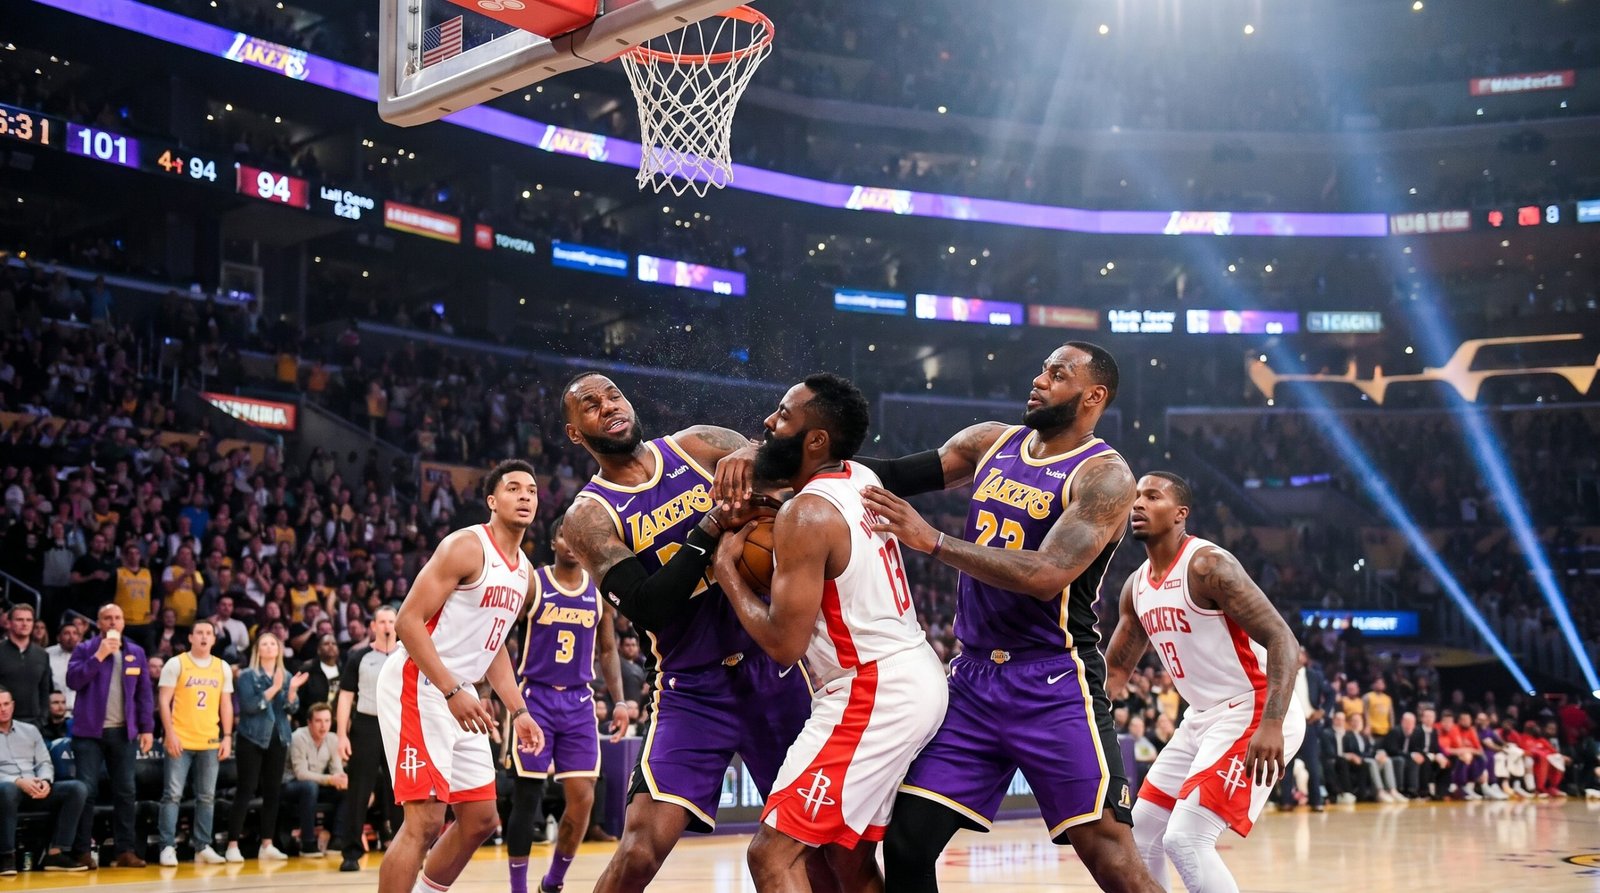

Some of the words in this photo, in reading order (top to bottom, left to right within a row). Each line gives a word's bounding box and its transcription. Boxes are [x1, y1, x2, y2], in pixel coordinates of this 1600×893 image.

[78, 128, 127, 164] 101
[190, 157, 217, 182] 94
[257, 171, 291, 202] 94
[495, 233, 536, 254] TOYOTA
[972, 467, 1055, 520] LAKERS
[626, 484, 714, 555] LAKERS
[975, 509, 1025, 550] 23
[878, 537, 911, 617] 13
[480, 586, 524, 614] ROCKET
[537, 602, 597, 628] LAKERS
[484, 617, 506, 652] 13
[555, 630, 576, 664] 3
[1160, 642, 1185, 679] 13
[197, 690, 207, 708] 2
